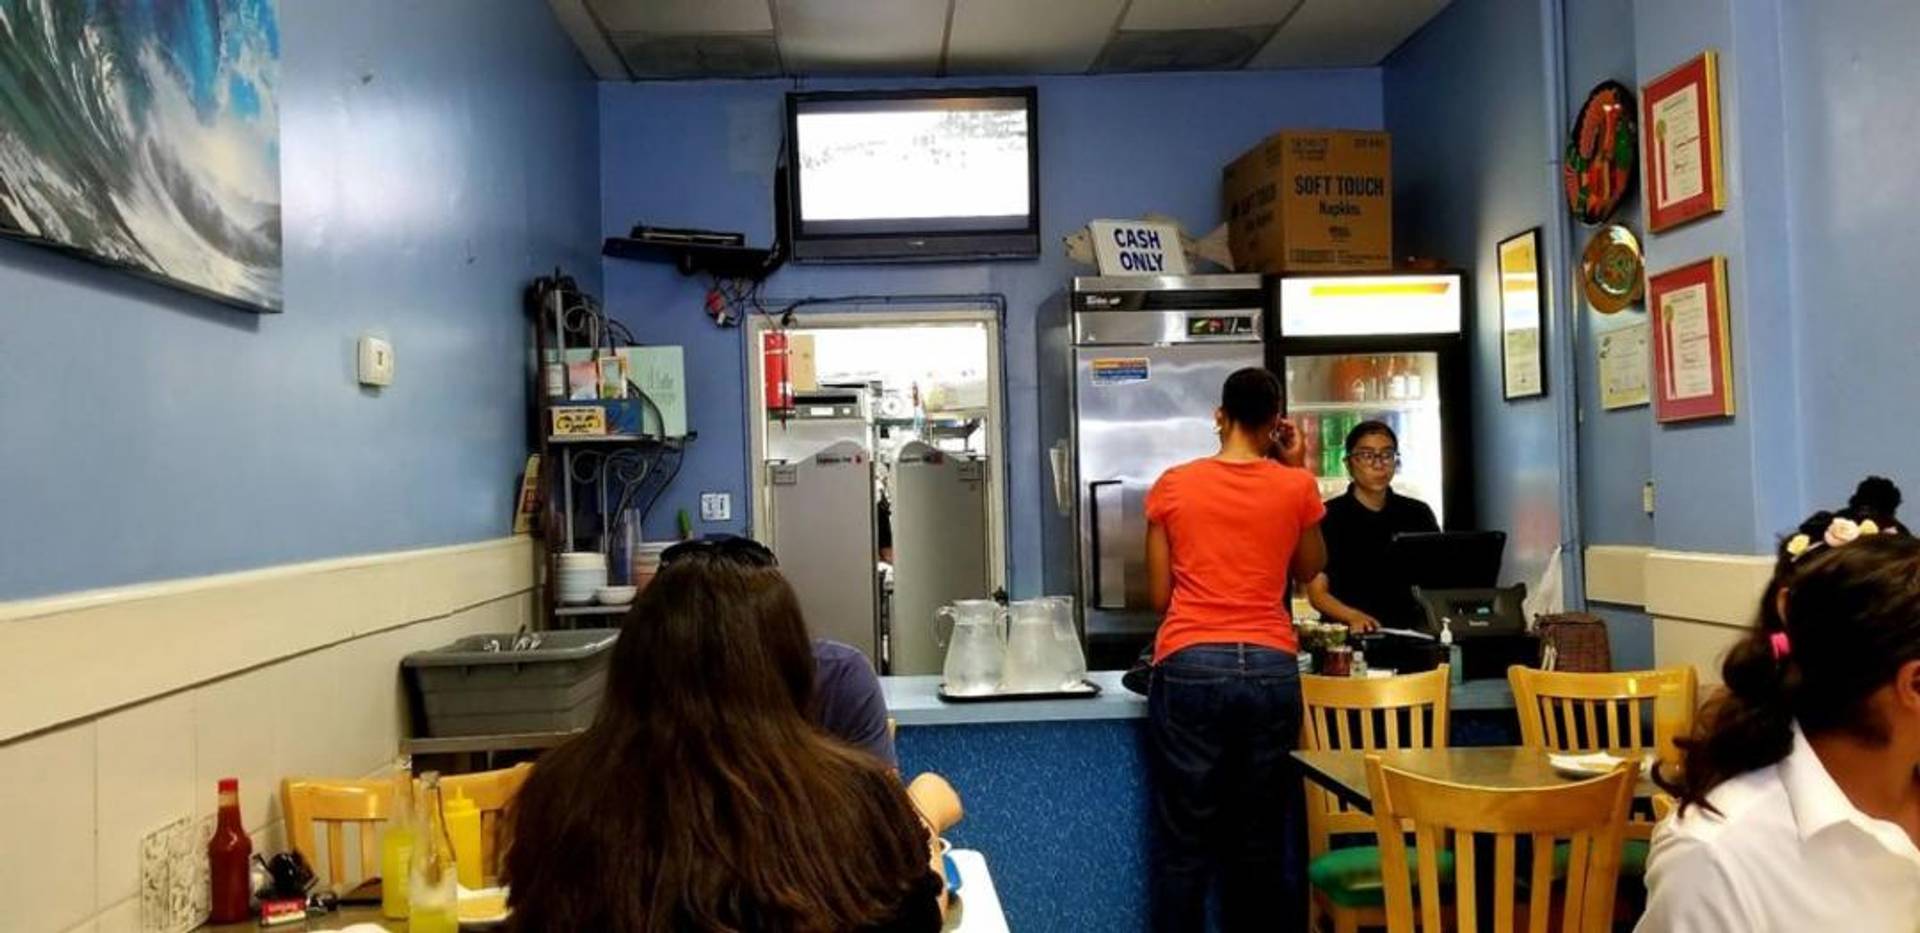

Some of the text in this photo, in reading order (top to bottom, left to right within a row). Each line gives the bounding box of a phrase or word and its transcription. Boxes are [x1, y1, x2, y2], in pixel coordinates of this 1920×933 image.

[1294, 175, 1384, 196] SOFT TOUCH
[1113, 228, 1161, 249] CASH
[1119, 251, 1164, 272] ONLY
